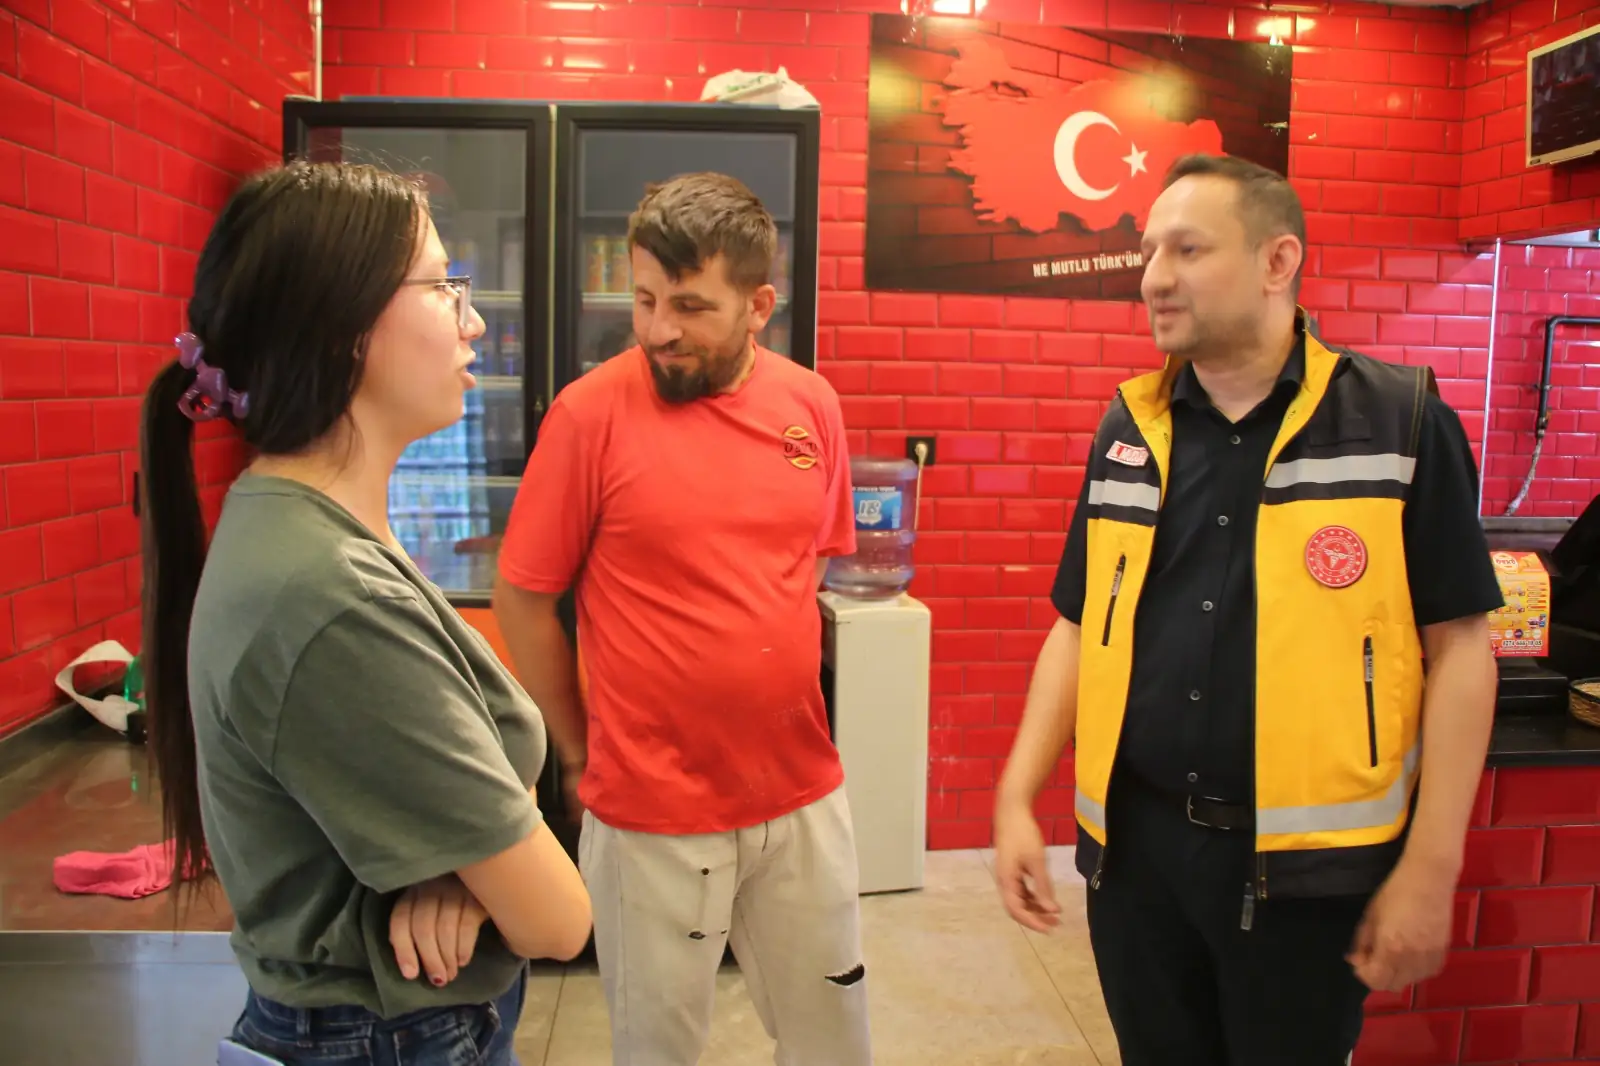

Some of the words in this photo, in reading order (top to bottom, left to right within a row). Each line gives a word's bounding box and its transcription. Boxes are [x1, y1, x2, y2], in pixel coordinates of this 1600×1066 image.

[1033, 262, 1049, 277] NE
[1051, 258, 1090, 276] MUTLU
[1092, 250, 1143, 271] TÜRK'ÜM
